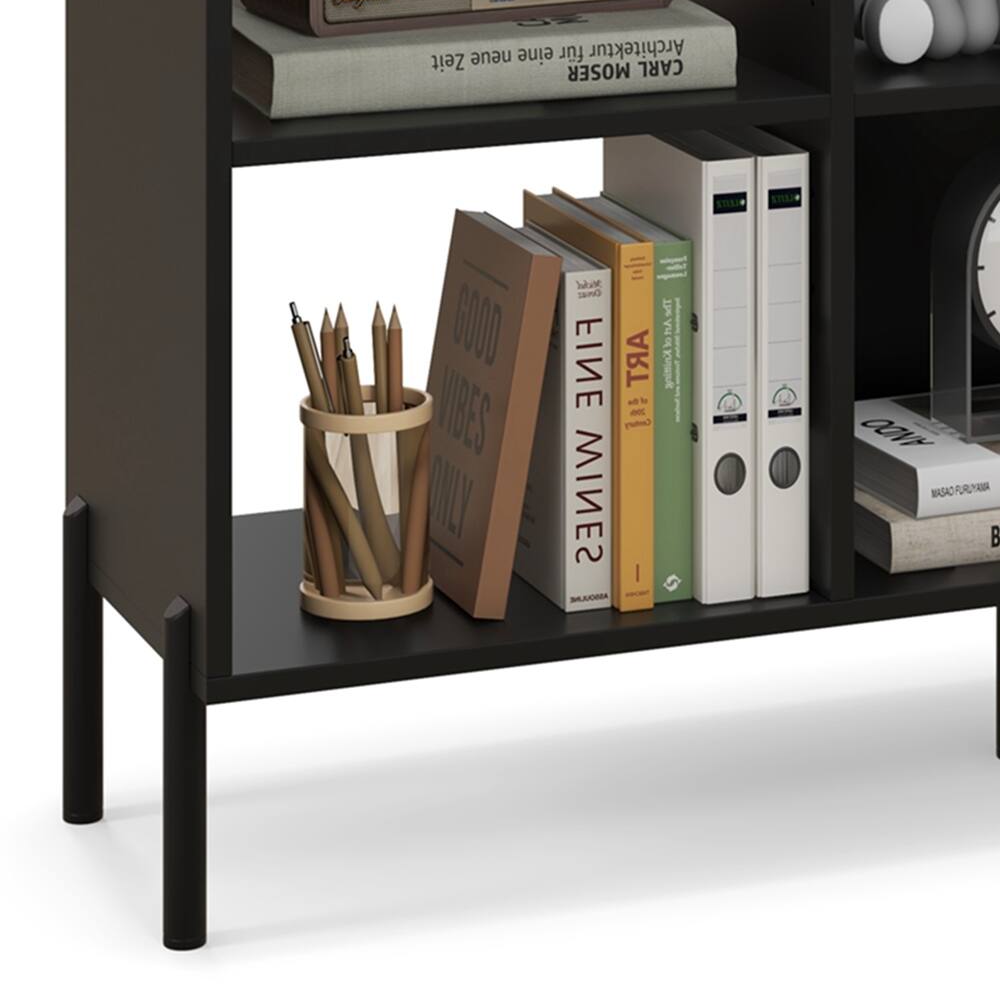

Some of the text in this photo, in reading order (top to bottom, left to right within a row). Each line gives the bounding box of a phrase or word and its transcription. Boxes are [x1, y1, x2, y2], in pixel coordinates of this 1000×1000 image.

[432, 39, 685, 72] Architektur für eine neue Zeit
[568, 59, 684, 82] CARL MOSER
[453, 282, 501, 367] GOOD
[440, 364, 491, 456] VIBES
[430, 453, 474, 539] ONLY
[931, 482, 991, 498] MASAO FURUYAMA
